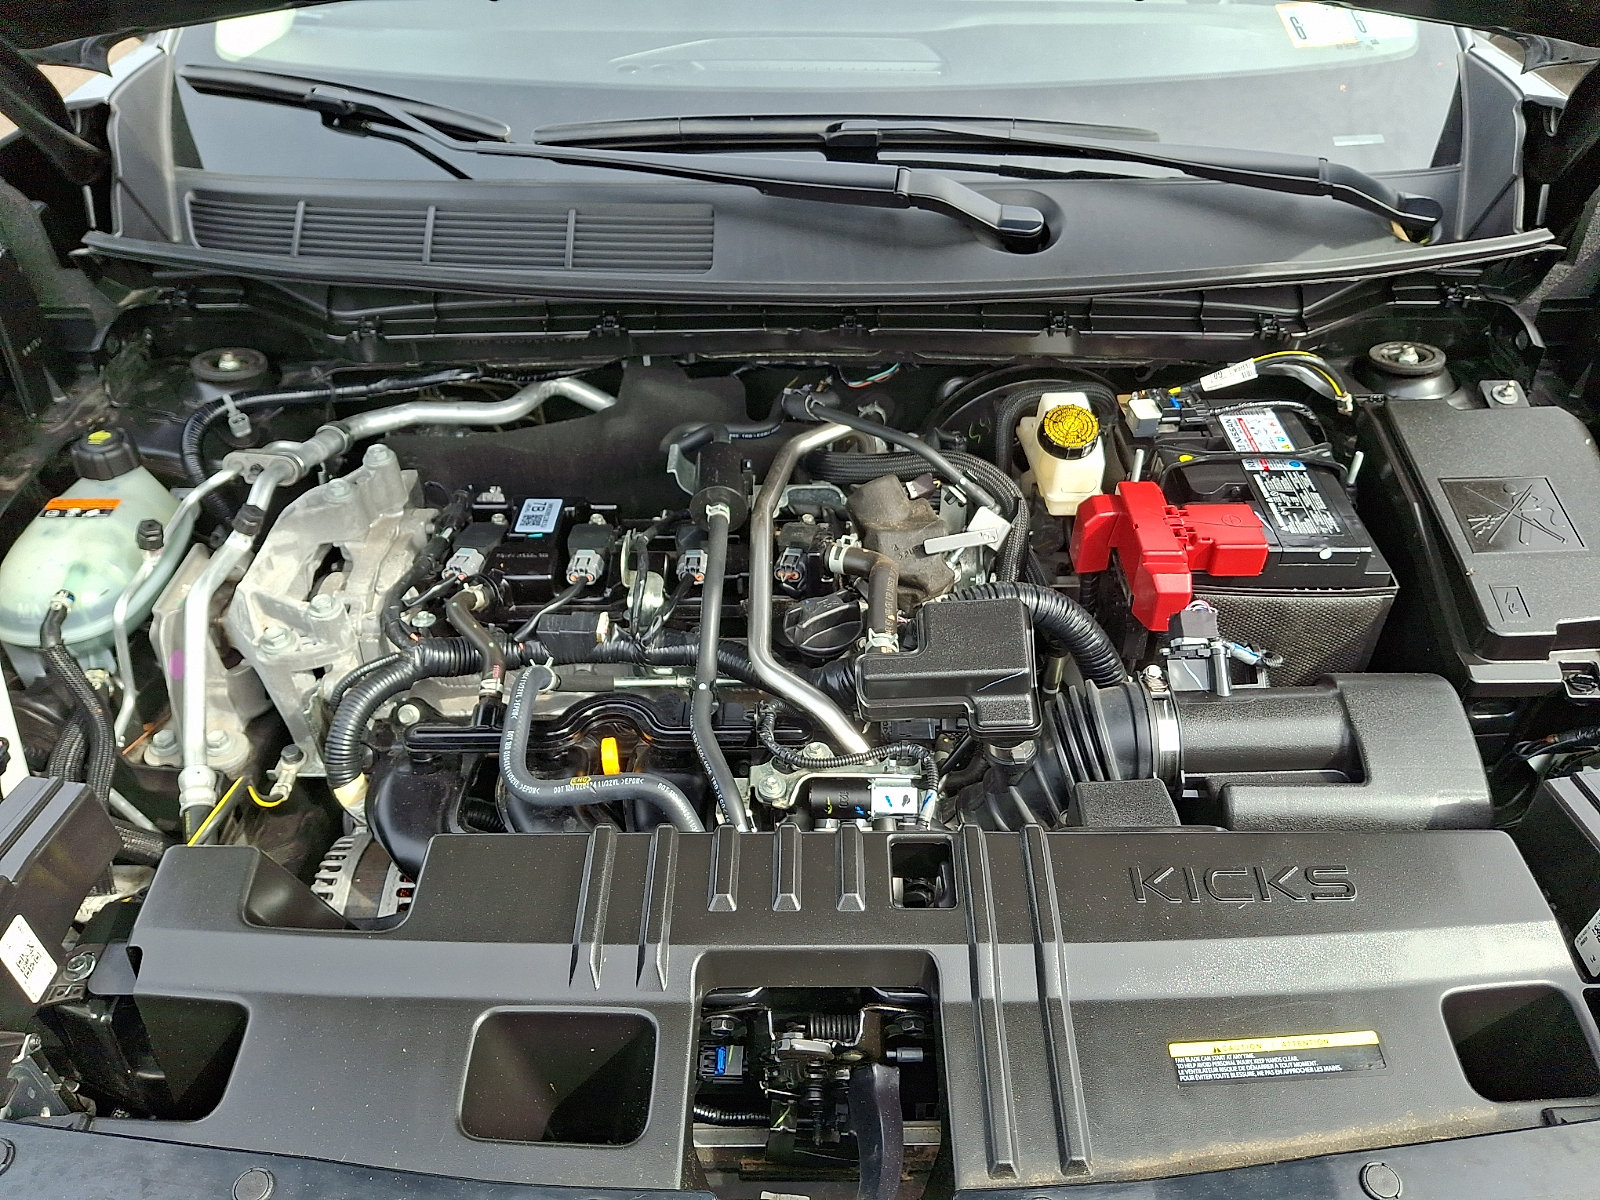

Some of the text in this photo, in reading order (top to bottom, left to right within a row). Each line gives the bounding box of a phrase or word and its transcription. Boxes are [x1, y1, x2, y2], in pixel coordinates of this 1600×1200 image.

[1128, 865, 1358, 903] KICKS
[1222, 1039, 1329, 1052] CAUTION ATTENTION
